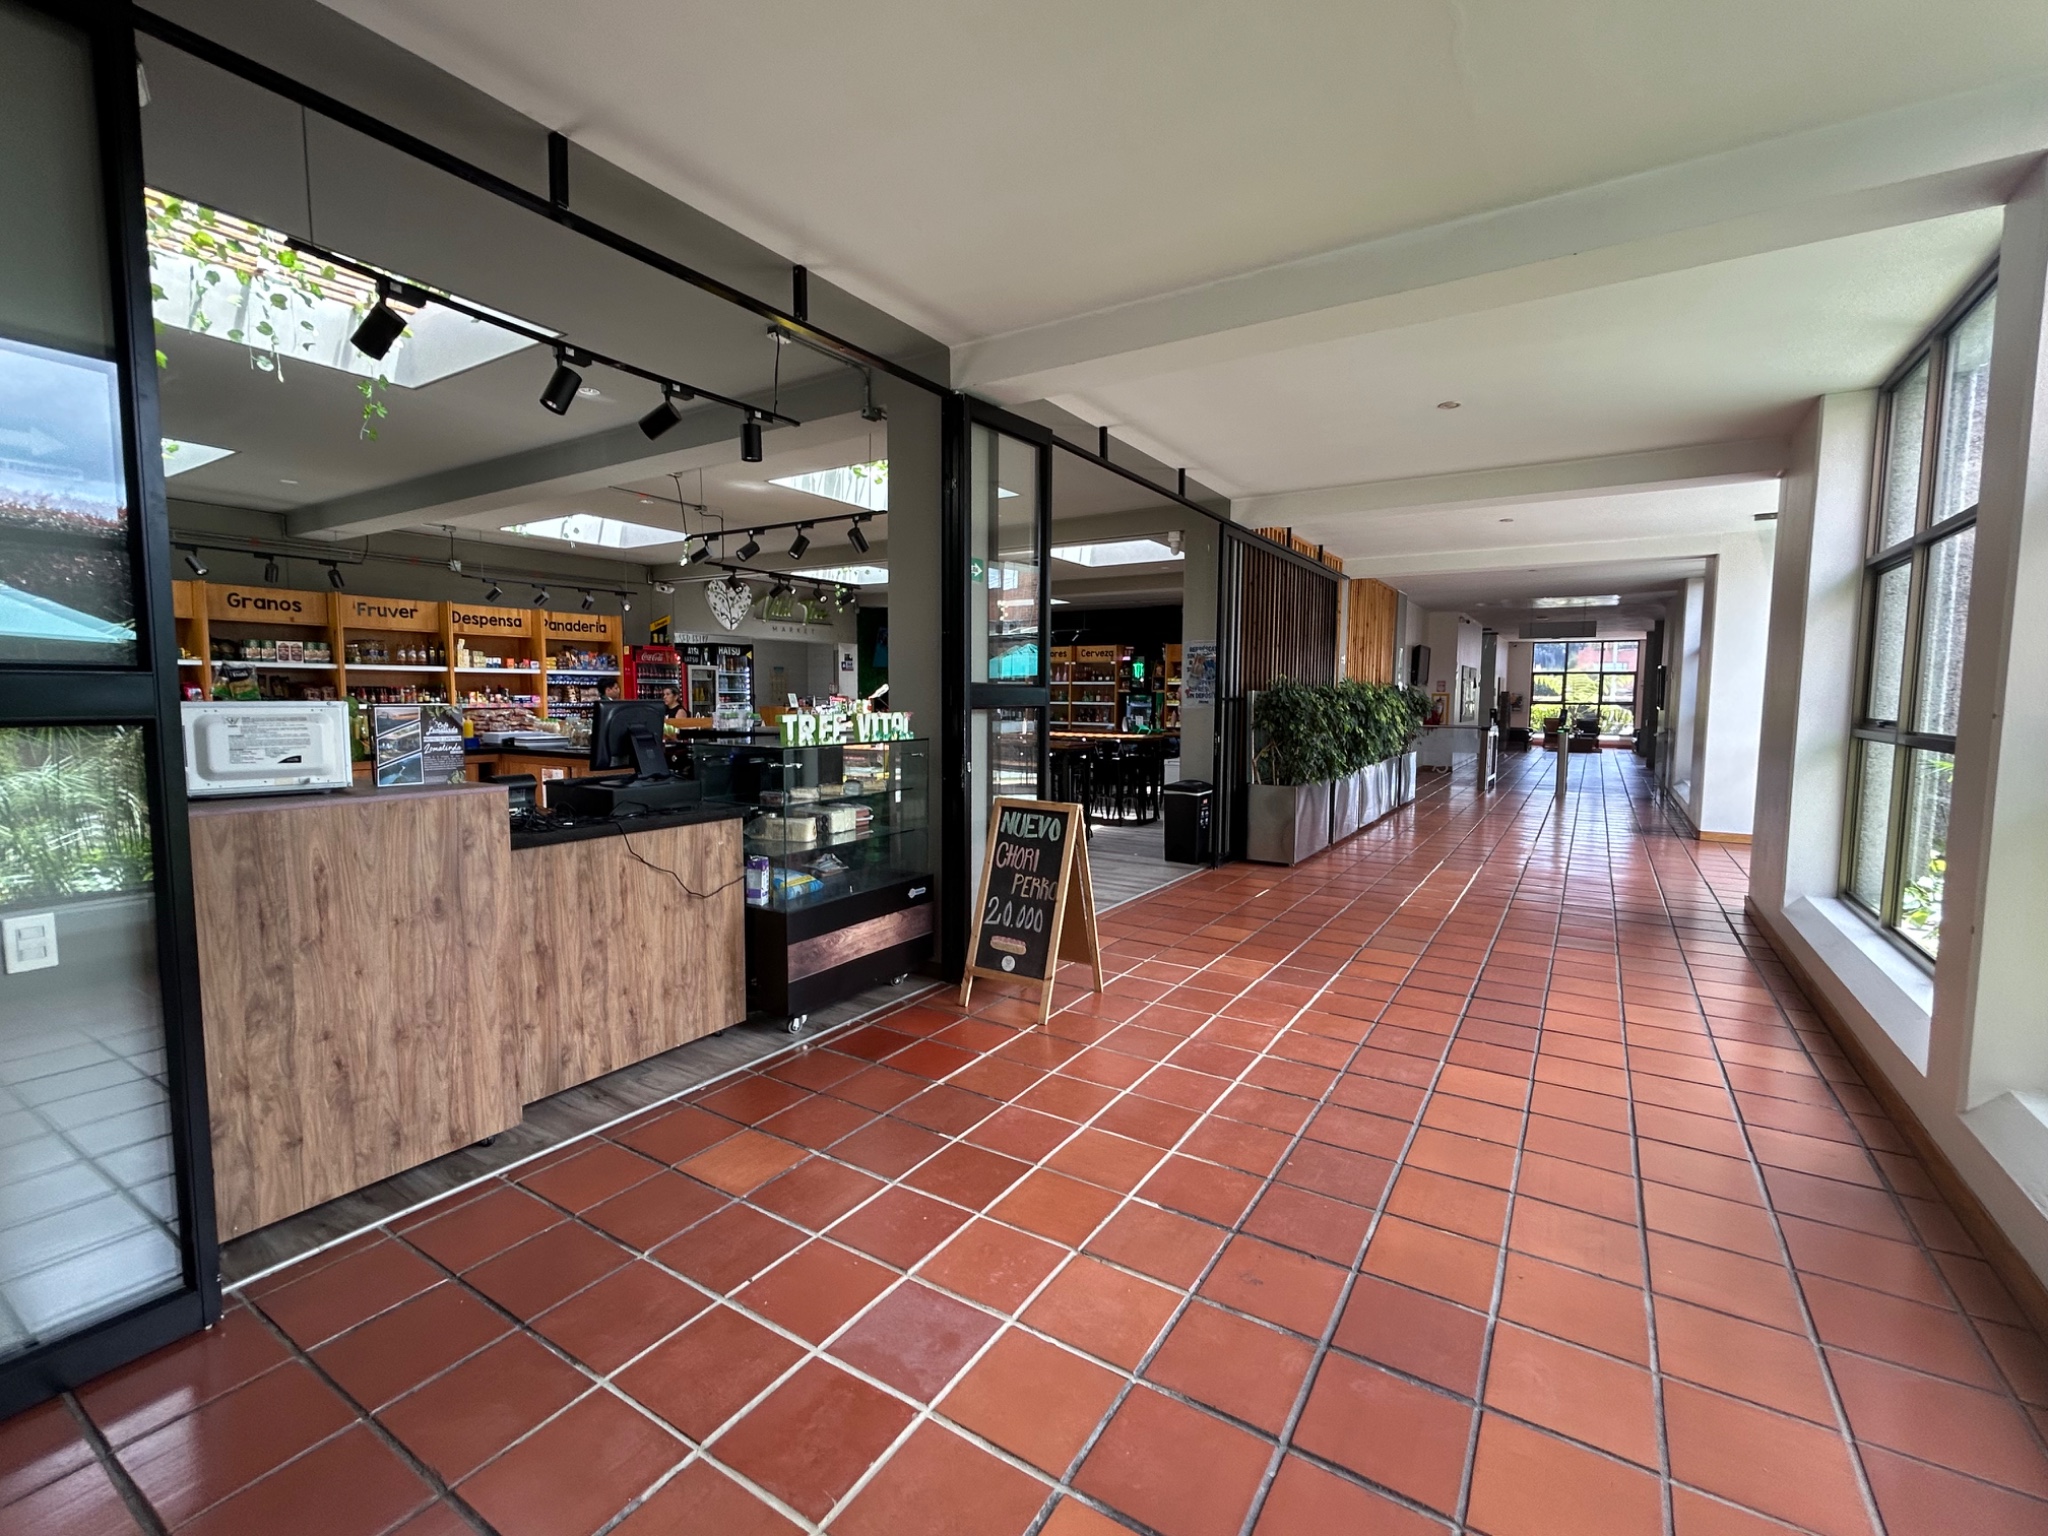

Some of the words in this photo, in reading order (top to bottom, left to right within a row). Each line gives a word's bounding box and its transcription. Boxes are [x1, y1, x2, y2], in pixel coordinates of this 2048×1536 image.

[226, 592, 302, 613] Granos
[356, 602, 418, 619] Fruver
[452, 611, 522, 628] Despensa
[772, 626, 815, 634] MARKET
[718, 646, 741, 656] HATSU
[1081, 649, 1114, 657] Cerveza
[780, 713, 847, 747] TREE
[856, 711, 914, 743] VITAL
[1000, 810, 1061, 842] NUEVO
[995, 841, 1040, 872] CHORI
[984, 896, 1043, 933] 20.000
